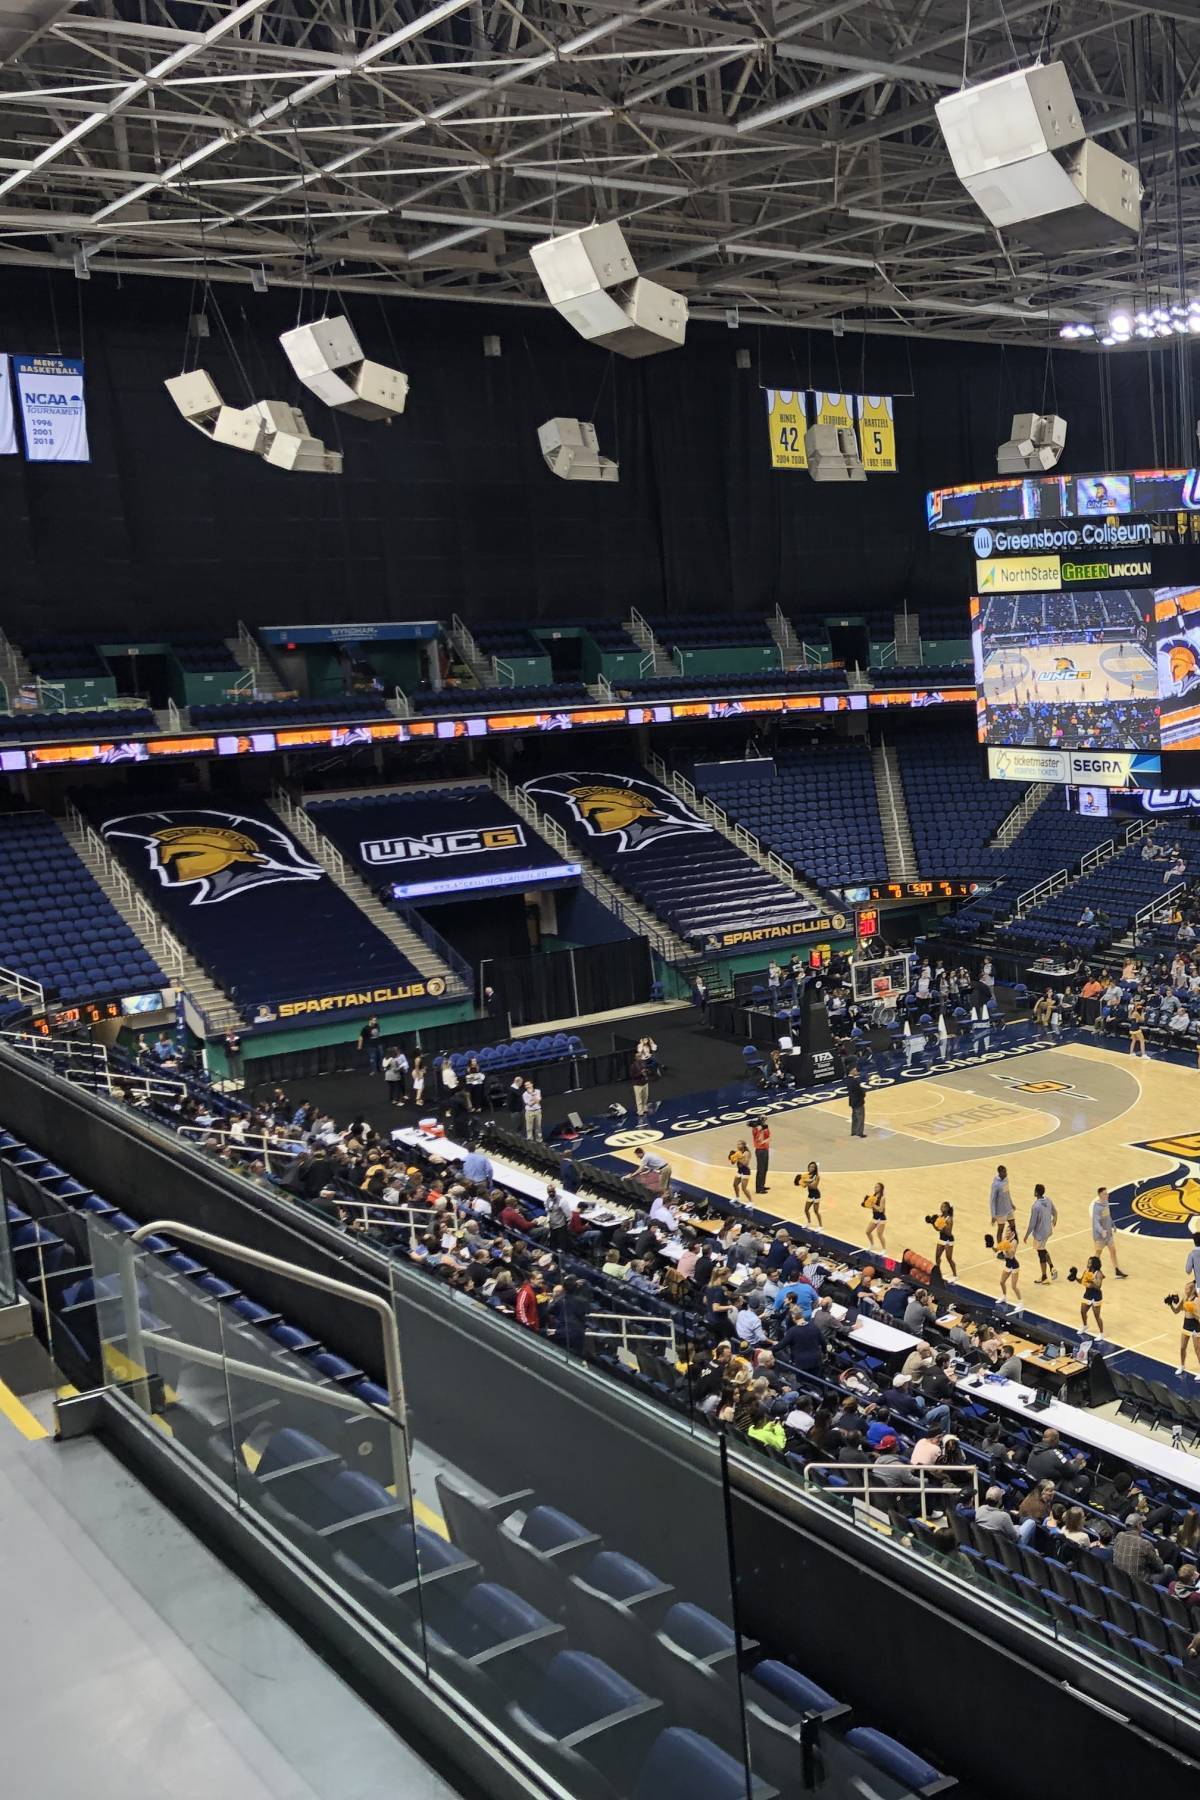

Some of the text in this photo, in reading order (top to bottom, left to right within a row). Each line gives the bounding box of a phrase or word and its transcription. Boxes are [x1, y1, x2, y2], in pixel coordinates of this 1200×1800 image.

[20, 365, 79, 375] BASKETBALL
[33, 358, 64, 368] MEN'S
[25, 393, 68, 405] NCAA
[31, 419, 53, 427] 1996
[33, 428, 53, 436] 2001
[780, 427, 800, 452] 42
[33, 437, 55, 445] 2018
[873, 431, 883, 455] 5
[995, 523, 1152, 551] Greensboro Coliseum
[1001, 566, 1059, 583] NorthState
[1062, 562, 1152, 581] GREEN LINCOLN
[1038, 669, 1092, 681] UNCG
[1013, 755, 1060, 768] ticketmaster
[1073, 759, 1122, 773] SEGRA
[367, 828, 521, 862] UNCG
[723, 918, 831, 946] SPARTAN CLUB
[278, 983, 426, 1018] SPARTAN CLUB
[901, 1040, 1056, 1078] Coliseum
